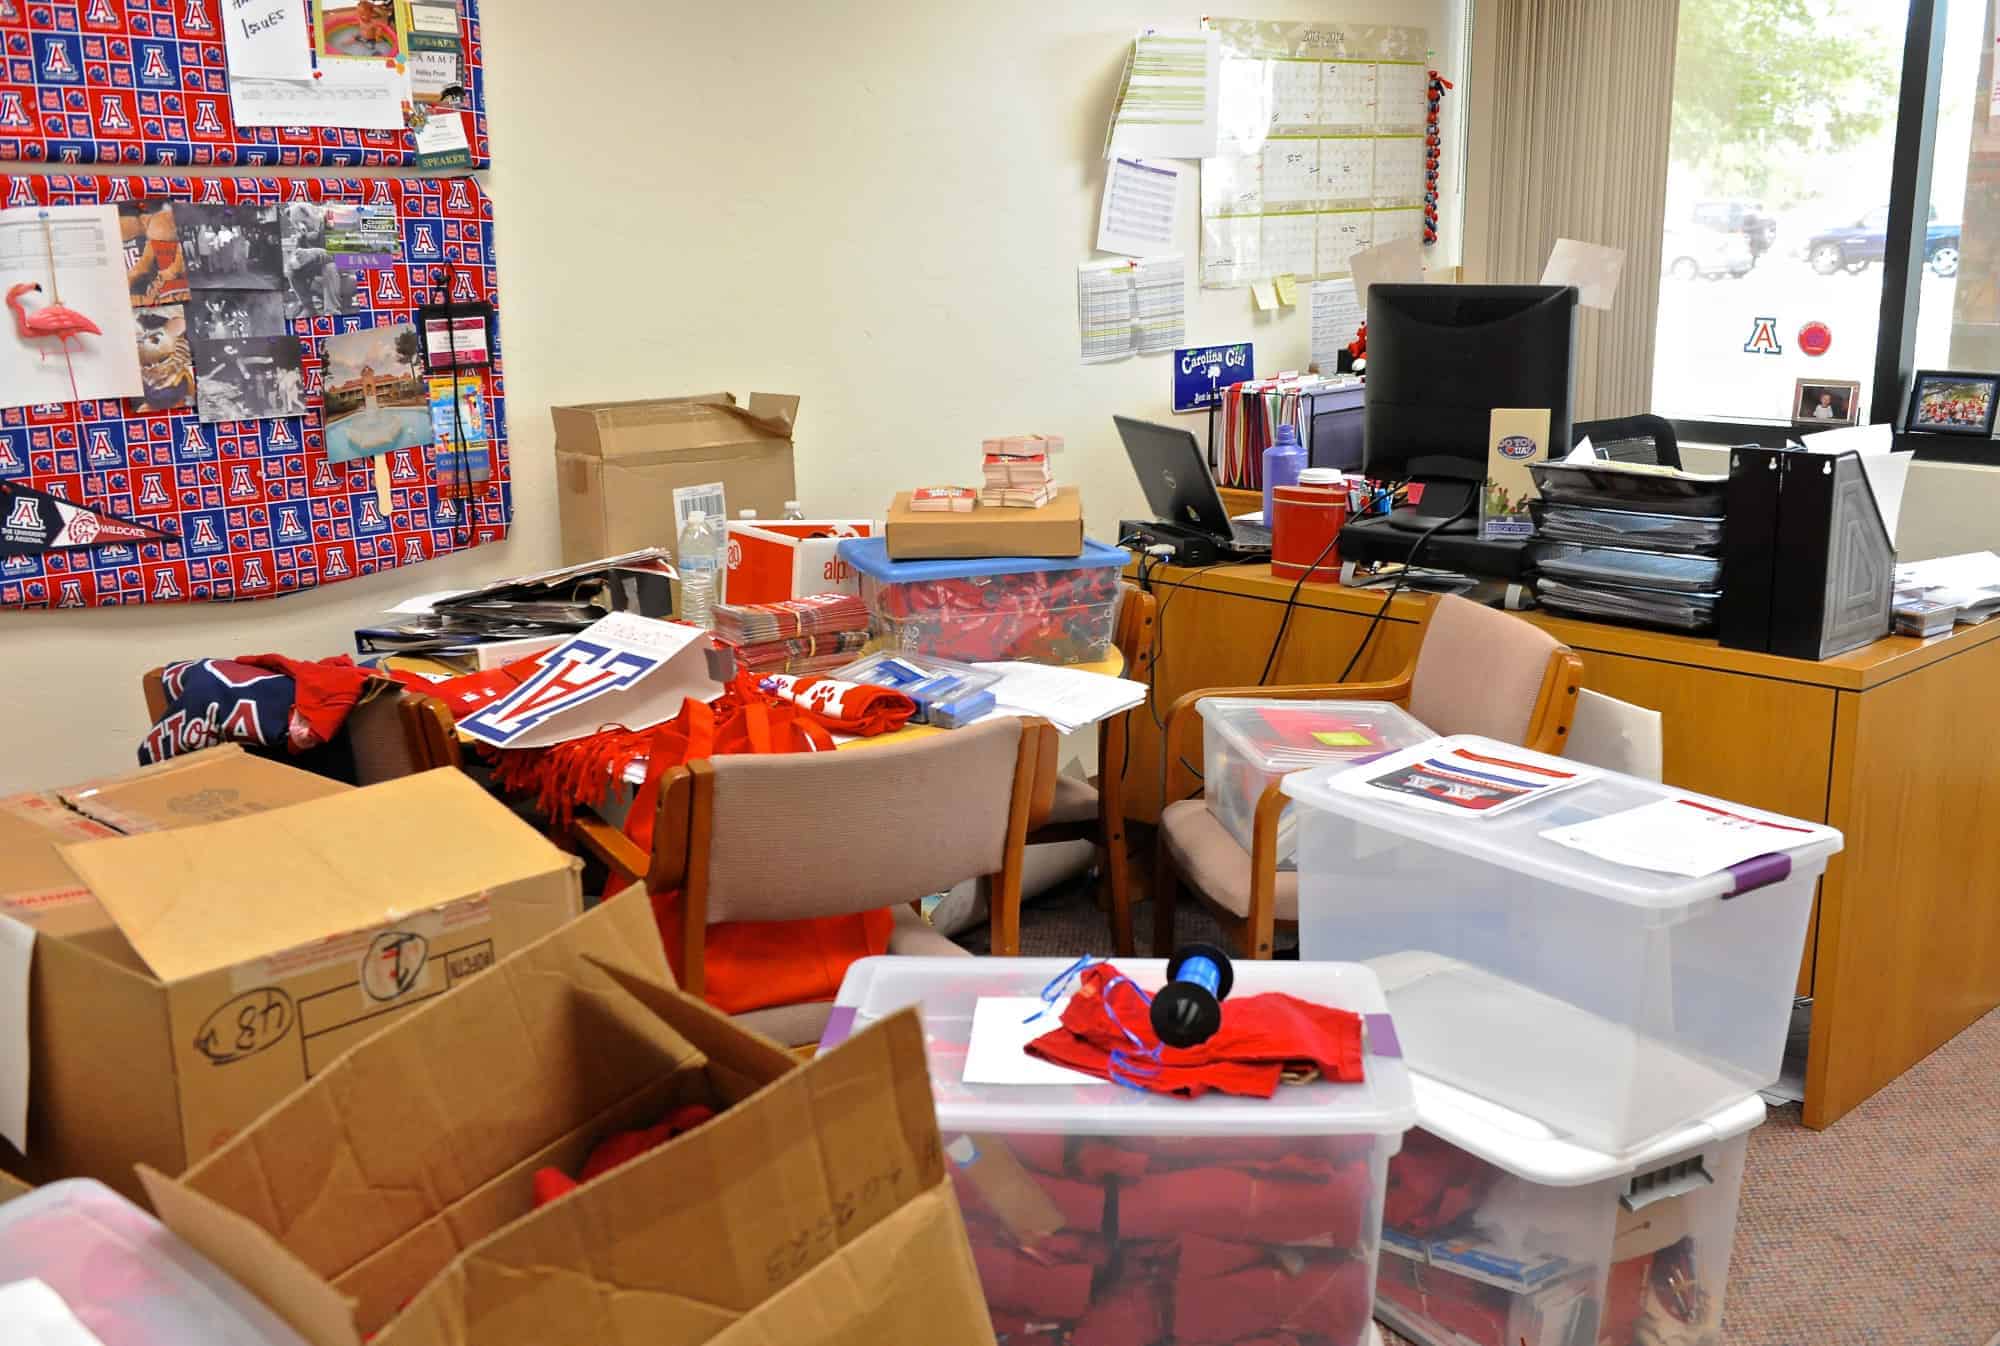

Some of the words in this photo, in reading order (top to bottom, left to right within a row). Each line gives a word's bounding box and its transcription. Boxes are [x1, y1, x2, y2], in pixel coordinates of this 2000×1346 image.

[184, 0, 212, 30] A
[44, 40, 74, 74] A
[143, 46, 170, 78] A
[1, 93, 30, 126] A
[101, 97, 130, 129] A
[195, 101, 223, 132] A
[9, 176, 38, 205] A
[201, 179, 225, 204] A
[369, 180, 393, 206] A
[448, 181, 471, 208] A
[413, 224, 437, 254] A
[377, 271, 402, 300] A
[453, 271, 477, 299] A
[1744, 317, 1782, 355] A
[1182, 351, 1222, 374] Carolina
[1226, 350, 1246, 367] Girl
[88, 428, 117, 460] A
[181, 423, 208, 452] A
[268, 418, 295, 446] A
[313, 459, 338, 489] A
[392, 450, 417, 480] A
[140, 474, 169, 505] A
[231, 465, 256, 496] A
[7, 497, 44, 530] A
[279, 507, 304, 536] A
[359, 498, 383, 527] A
[101, 524, 146, 537] WILDCATS
[192, 516, 220, 546] A
[325, 548, 350, 577] A
[402, 537, 425, 564] A
[151, 568, 180, 599] A
[241, 559, 268, 589] A
[57, 580, 84, 608] A
